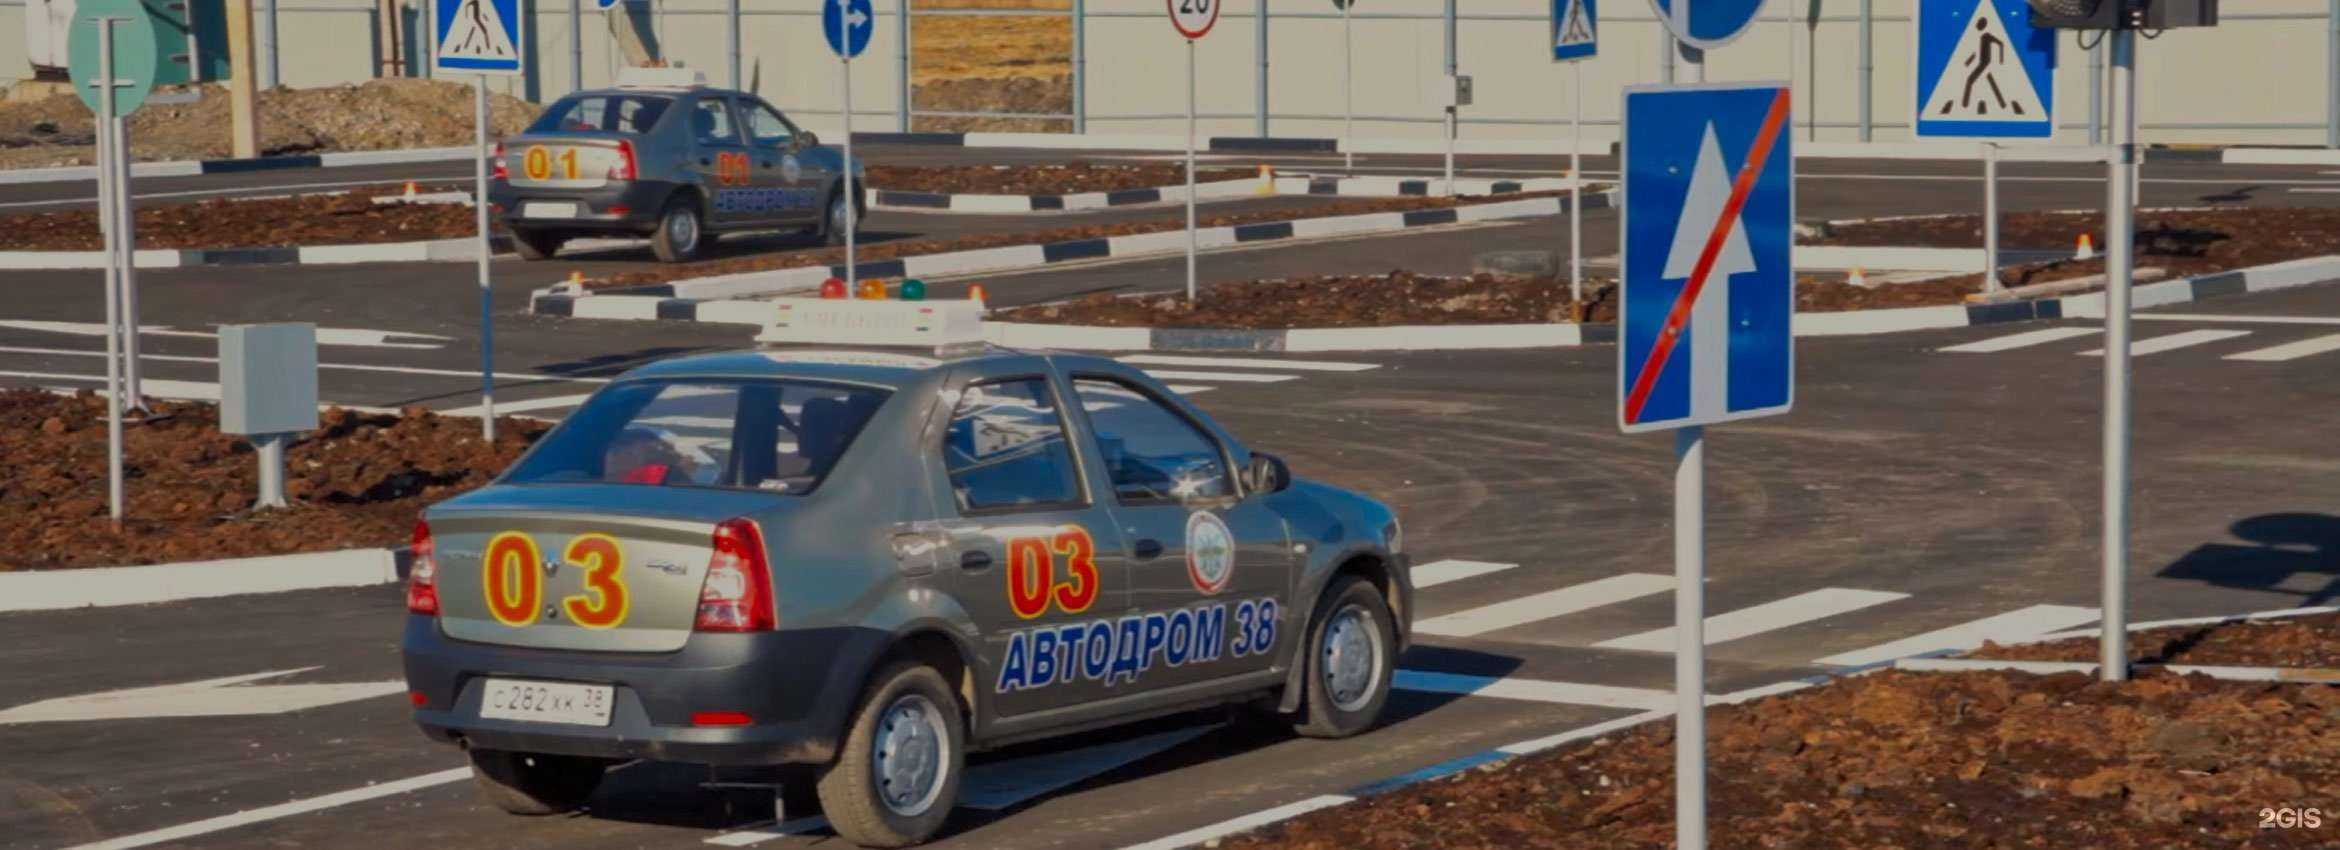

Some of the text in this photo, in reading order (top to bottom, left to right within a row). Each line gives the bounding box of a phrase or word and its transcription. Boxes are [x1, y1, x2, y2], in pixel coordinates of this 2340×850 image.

[717, 151, 750, 185] 01
[1006, 523, 1099, 619] 03
[995, 597, 1279, 694] АВТОДРОМ 38
